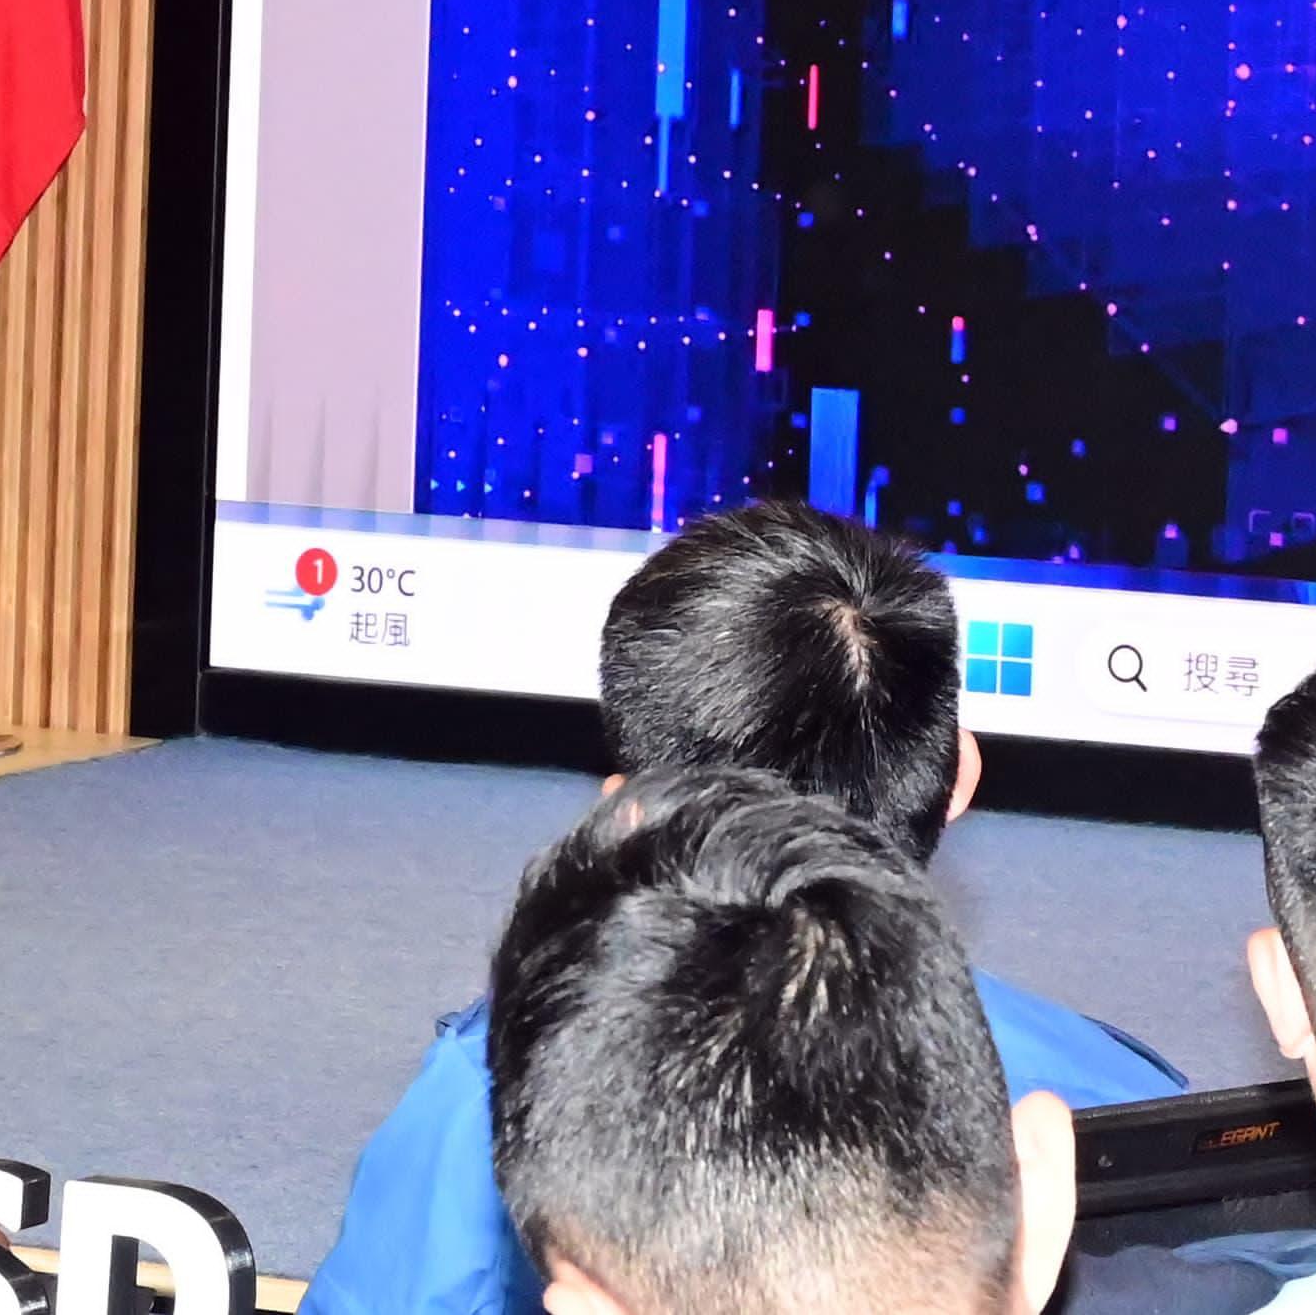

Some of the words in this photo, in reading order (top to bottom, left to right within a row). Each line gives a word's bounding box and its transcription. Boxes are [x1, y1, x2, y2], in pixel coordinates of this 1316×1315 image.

[313, 557, 325, 585] 1
[350, 565, 416, 597] 30°C
[349, 611, 410, 647] 起風
[1183, 652, 1260, 697] 搜尋
